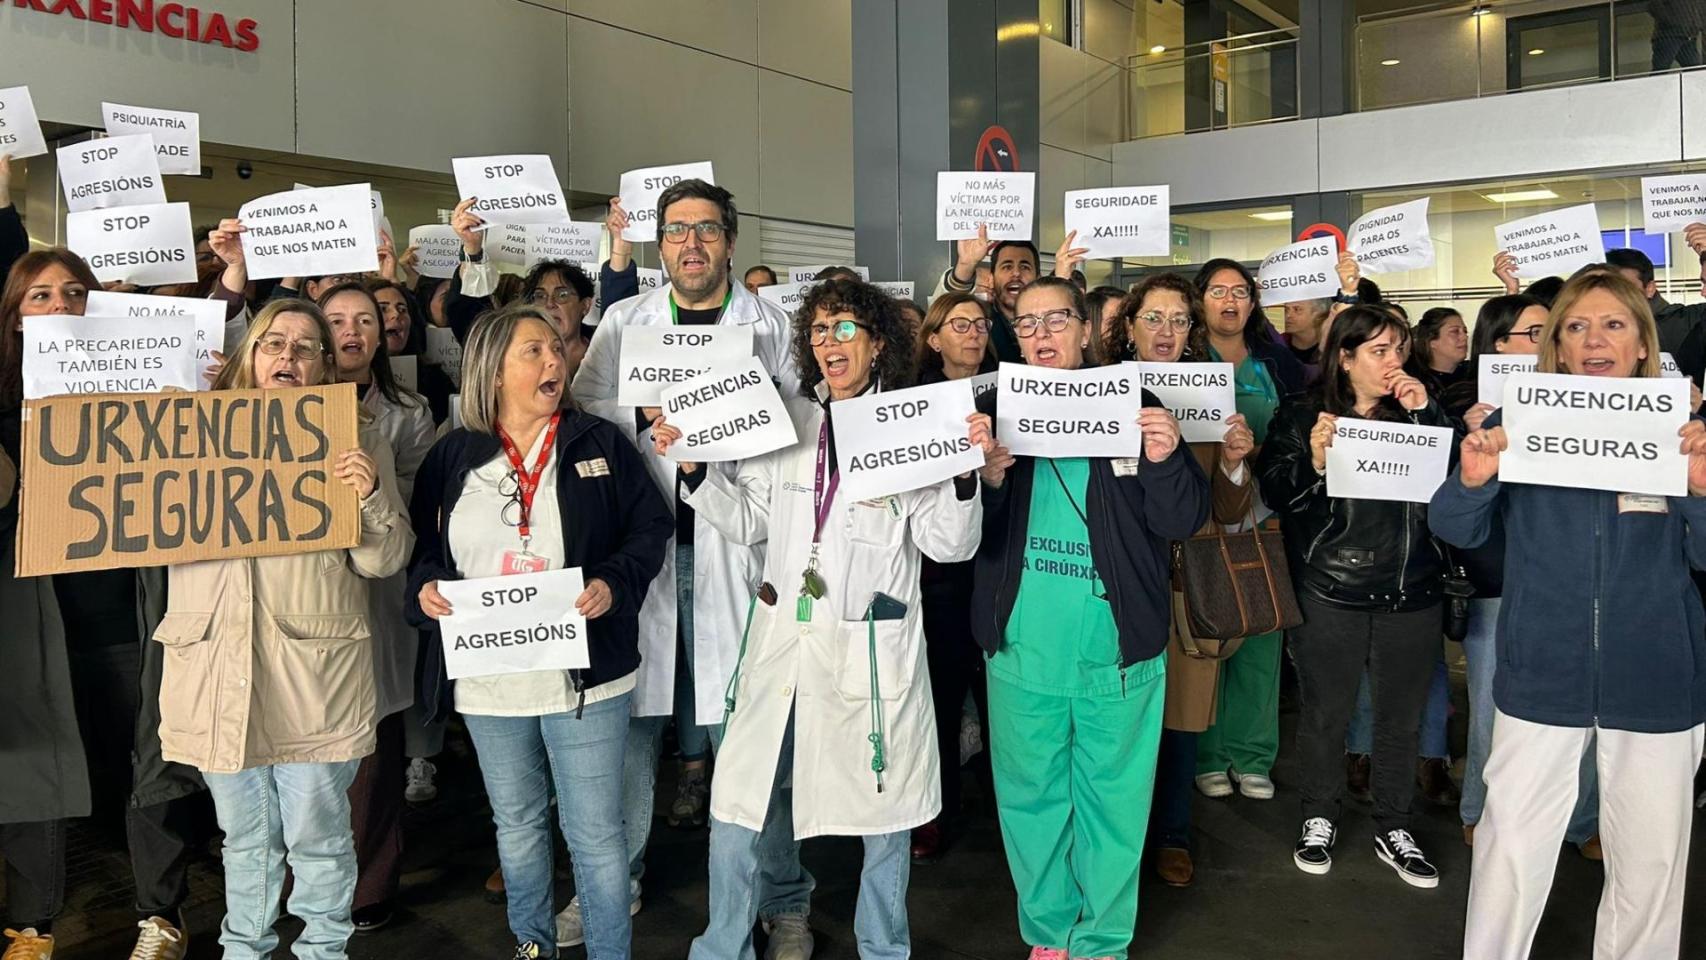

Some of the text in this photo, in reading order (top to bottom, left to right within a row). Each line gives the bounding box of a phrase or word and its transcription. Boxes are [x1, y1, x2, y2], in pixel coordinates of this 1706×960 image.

[0, 0, 260, 51] ENCIAS
[112, 112, 186, 130] PSIQUIATRÍA
[81, 147, 118, 164] STOP
[484, 164, 524, 179] STOP
[71, 175, 154, 200] AGRESIÓNS
[965, 178, 1006, 190] NO MÁS
[1650, 185, 1691, 194] VENIMOS
[470, 192, 557, 212] AGRESIÓNS
[950, 192, 1020, 204] VÍCTIMAS POR
[1075, 195, 1158, 209] SEGURIDADE
[1651, 196, 1706, 206] TRABAJAR,N
[248, 203, 318, 219] VENIMOS A
[945, 208, 1024, 218] LA NEGLIGENCIA
[1651, 210, 1671, 219] QUE
[103, 215, 150, 232] STOP
[249, 218, 348, 238] TRABAJAR,NO A
[562, 226, 580, 235] MÁS
[953, 221, 1015, 232] DEL STEMA
[1093, 225, 1139, 238] XA!!!!!
[1358, 213, 1404, 232] DIGNIDAD
[536, 235, 574, 246] VÍCTIMAS
[1361, 229, 1400, 246] PARA OS
[1504, 223, 1557, 241] VENIMOS A
[1573, 232, 1581, 240] A
[254, 237, 357, 257] QUE NOS MATEN
[415, 237, 460, 246] MALA GEST
[543, 247, 594, 257] NEGLIGENCIA
[1357, 244, 1409, 262] PACIENTES
[1531, 252, 1551, 262] NOS
[1553, 244, 1588, 258] MATEN
[1262, 272, 1327, 290] SEGURAS
[128, 306, 150, 316] NO
[38, 336, 182, 354] LA PRECARIEDAD
[662, 334, 713, 347] STOP
[57, 354, 163, 373] TAMBIÉN ES
[628, 366, 711, 382] AGRES
[64, 378, 157, 394] VIOLENCIA
[668, 370, 761, 414] URXENCIAS
[1010, 377, 1130, 397] URXENCIAS
[1516, 387, 1673, 413] URXENCIAS
[876, 399, 929, 423] STOP
[1167, 408, 1222, 421] URAS
[40, 394, 330, 465] URXENCIAS
[687, 409, 771, 448] SEGURAS
[1018, 418, 1120, 435] SEGURAS
[1338, 426, 1438, 448] SEGURIDADE
[849, 437, 971, 473] AGRESIÓNS
[1526, 435, 1658, 460] SEGURAS
[1356, 459, 1410, 477] XA!!!!!
[66, 467, 332, 560] SEGURAS
[1030, 536, 1089, 557] EXCLUSI
[481, 586, 538, 607] STOP
[454, 623, 576, 651] AGRESIÓNS
